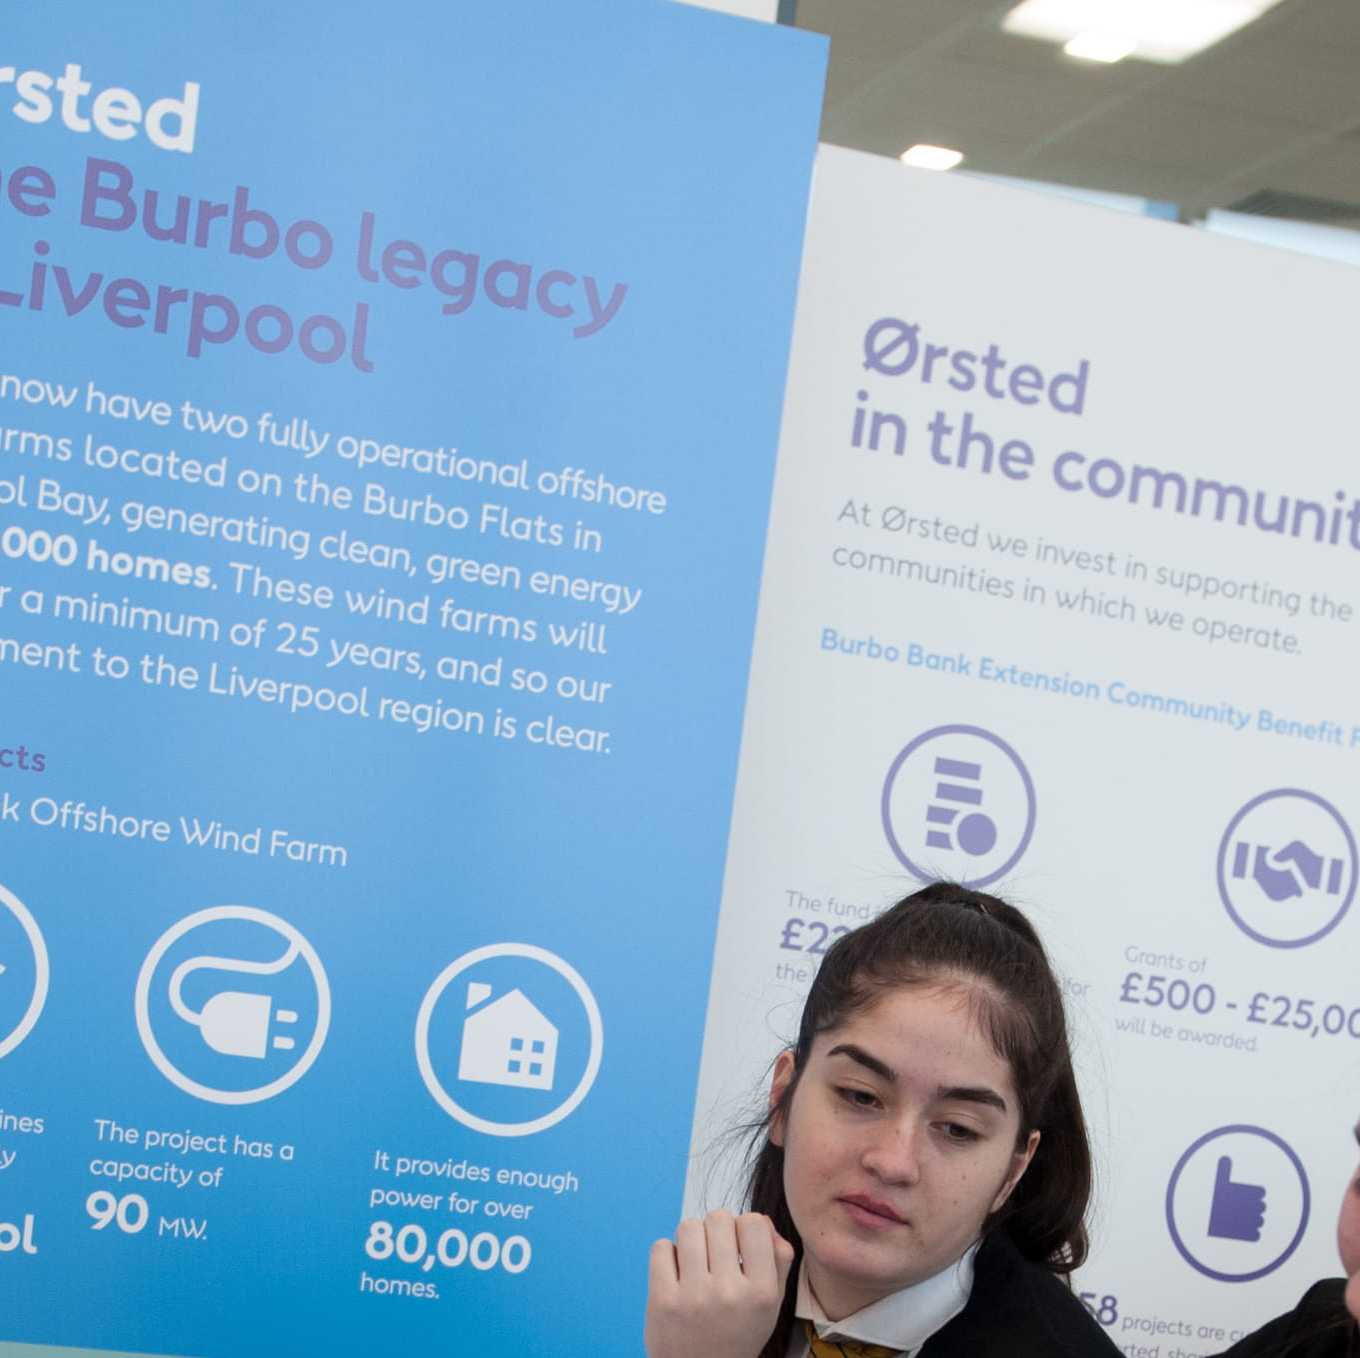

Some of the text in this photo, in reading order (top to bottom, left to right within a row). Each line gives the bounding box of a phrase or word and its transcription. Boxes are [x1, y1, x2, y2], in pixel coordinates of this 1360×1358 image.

[81, 157, 333, 269] Burbo
[358, 212, 627, 338] legacy
[863, 317, 1090, 416] Ørsted
[0, 375, 78, 407] now
[86, 382, 172, 425] have
[181, 401, 248, 438] two
[258, 413, 329, 458] fully
[337, 436, 529, 490] operational
[538, 467, 666, 514] offshore
[851, 390, 907, 456] in
[927, 411, 1035, 481] the
[85, 434, 227, 487] located
[238, 470, 281, 496] on
[295, 474, 352, 509] the
[364, 483, 469, 529] Burbo
[481, 504, 563, 545] Flats
[575, 521, 601, 552] in
[38, 478, 111, 525] Bay,
[121, 502, 310, 560] generating
[319, 531, 416, 576] clean,
[427, 554, 520, 588] green
[530, 572, 642, 614] energy
[837, 499, 1352, 622] At Ørsted we invest in supporting the
[87, 539, 217, 589] homes.
[229, 562, 333, 608] These
[345, 589, 429, 624] wind
[440, 599, 536, 641] farms
[549, 622, 607, 654] will
[832, 548, 1301, 654] communities in which we operate.
[21, 590, 43, 614] a
[54, 593, 219, 641] minimum
[230, 619, 267, 648] of
[276, 622, 319, 656] 25
[326, 640, 426, 680] years,
[437, 657, 502, 686] and
[511, 669, 547, 693] so
[557, 676, 612, 702] our
[92, 648, 129, 678] to
[140, 654, 199, 689] the
[209, 663, 369, 717] Liverpool
[379, 698, 483, 734] region
[494, 708, 516, 738] is
[527, 716, 610, 753] clear.
[821, 628, 899, 662] Burbo
[907, 643, 971, 676] Bank
[979, 657, 1100, 699] Extension
[1107, 682, 1251, 730] Community
[1257, 709, 1343, 744] Benefit
[30, 797, 170, 841] Offshore
[180, 817, 261, 854] Wind
[270, 830, 347, 866] Farm
[786, 890, 821, 912] The
[828, 897, 869, 916] fund
[775, 963, 807, 983] the
[1125, 945, 1207, 973] Grants of
[1119, 972, 1216, 1015] £500
[1115, 1018, 1260, 1052] will be awarded.
[94, 1119, 294, 1160] The project has a
[89, 1160, 223, 1188] capacity of
[374, 1150, 578, 1194] It provides enough
[85, 1190, 207, 1240] 90 MW.
[370, 1189, 533, 1219] power for over
[364, 1220, 532, 1274] 80,000
[359, 1271, 440, 1299] homes.
[1122, 1315, 1192, 1336] projects
[1197, 1324, 1226, 1341] are
